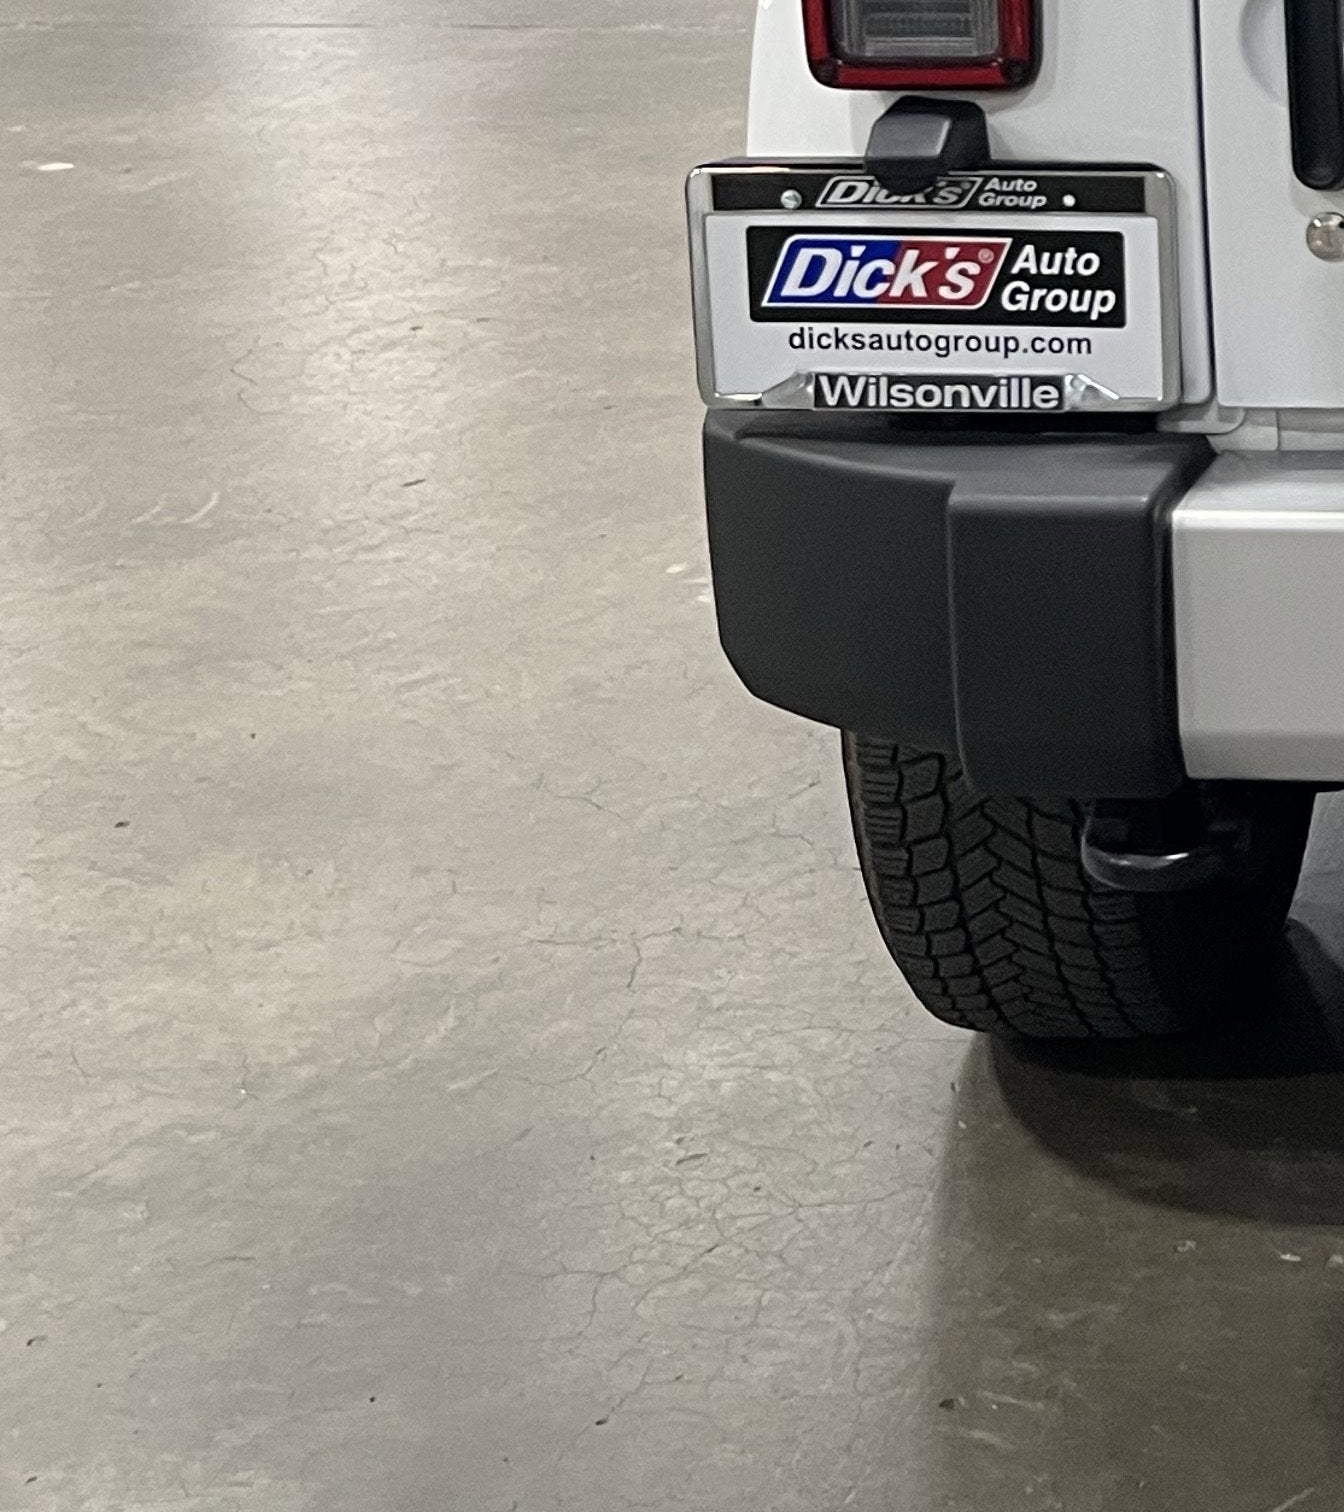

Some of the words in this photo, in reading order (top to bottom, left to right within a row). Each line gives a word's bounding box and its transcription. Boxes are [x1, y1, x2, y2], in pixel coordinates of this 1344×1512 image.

[978, 191, 1048, 209] Group
[984, 177, 1037, 192] Auto
[779, 244, 981, 300] Dick's
[1011, 245, 1101, 277] Auto
[1001, 281, 1117, 321] Group
[788, 326, 1093, 360] dicksautogroup.com
[818, 374, 1060, 410] Wilsonville
